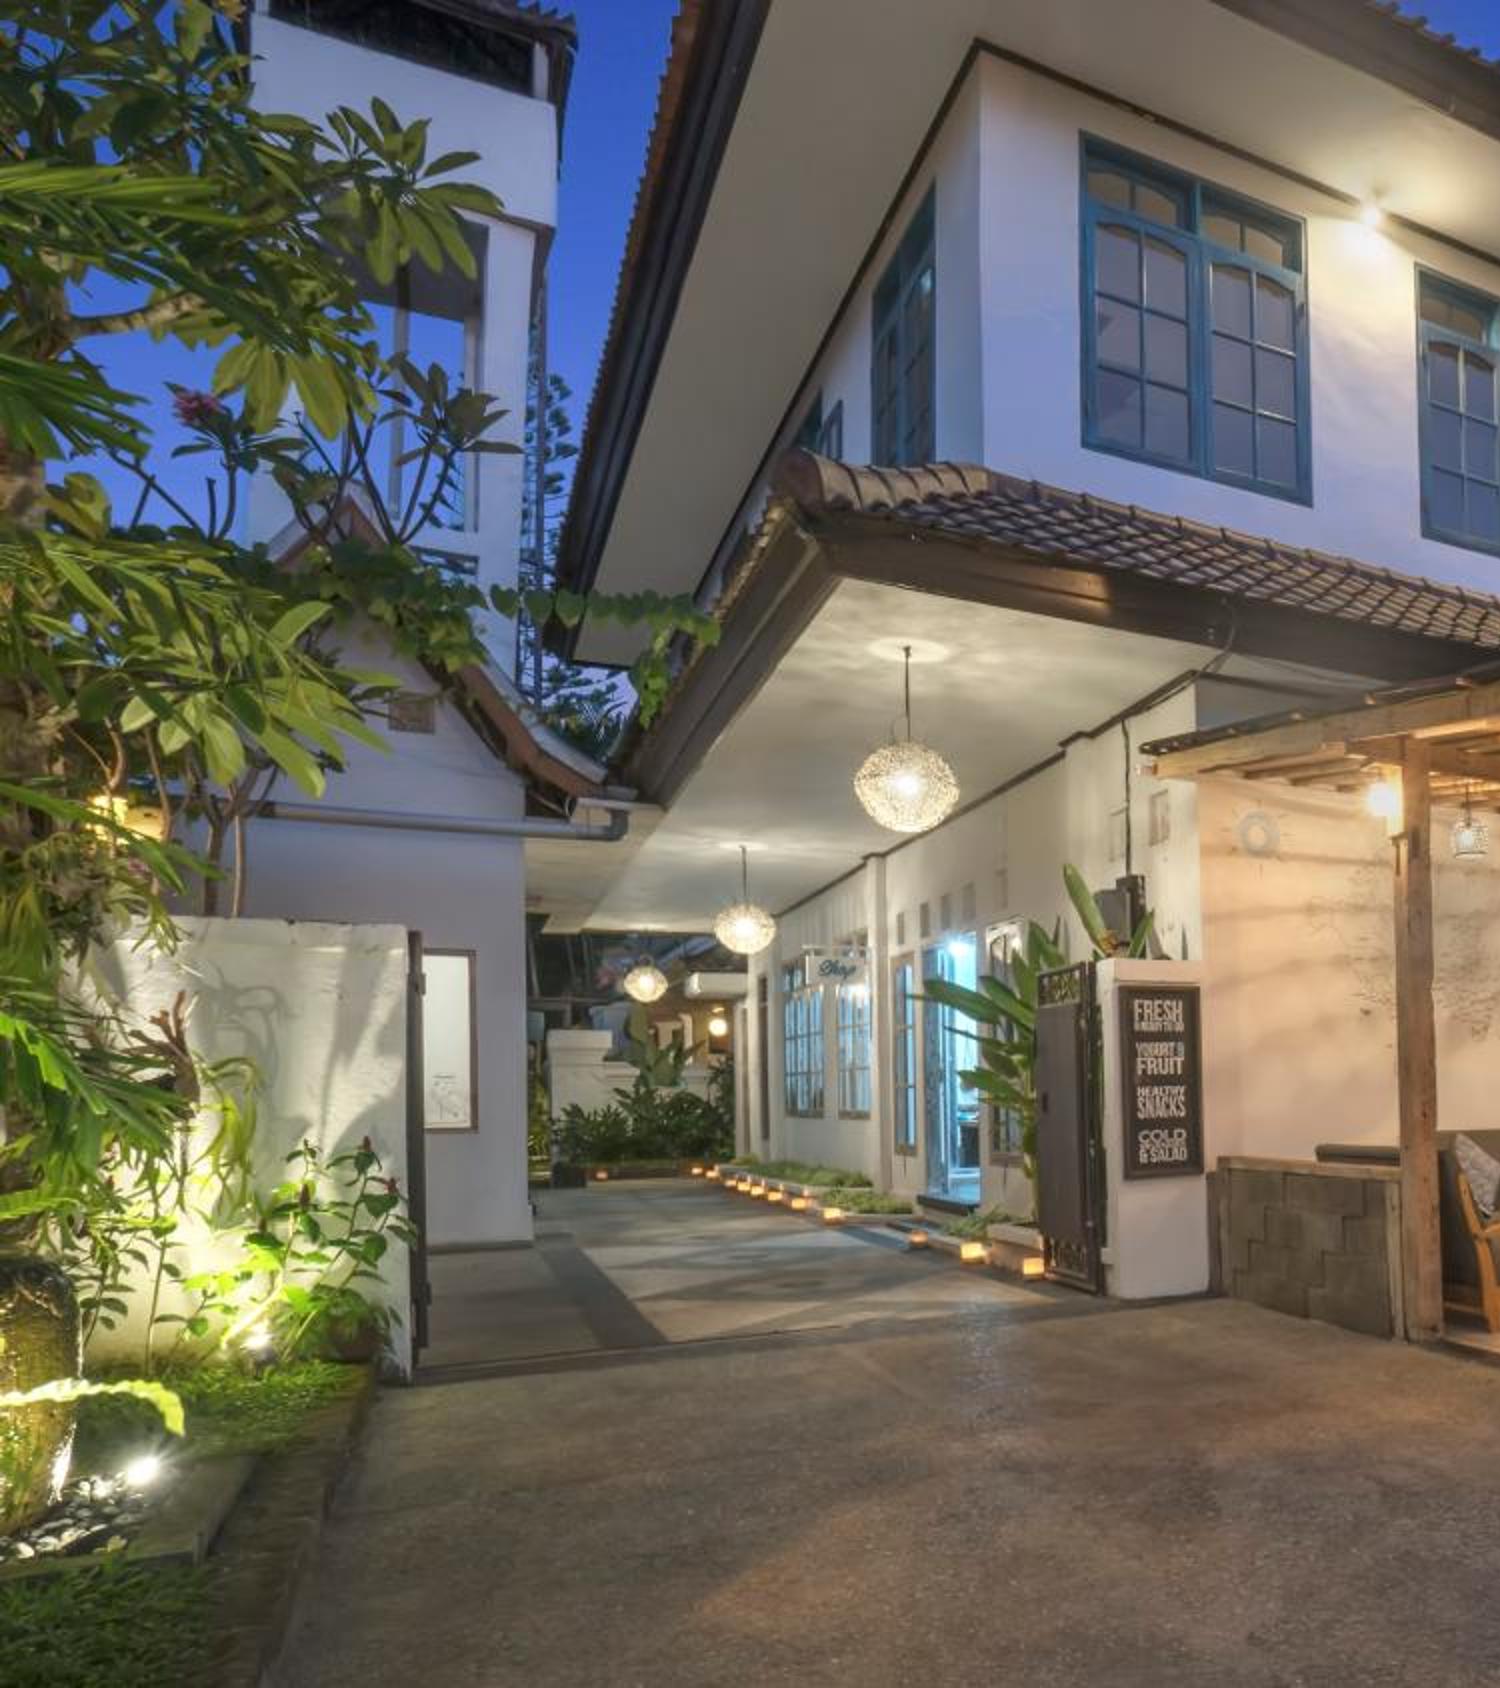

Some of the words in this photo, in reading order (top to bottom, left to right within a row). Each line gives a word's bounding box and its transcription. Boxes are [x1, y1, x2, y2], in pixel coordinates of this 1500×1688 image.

[1134, 999, 1183, 1022] FRESH
[1136, 1057, 1184, 1075] FRUIT
[1137, 1086, 1184, 1097] HEALTHY
[1137, 1095, 1186, 1119] SNACKS
[1138, 1129, 1186, 1142] COLD
[1150, 1147, 1188, 1162] SALAD
